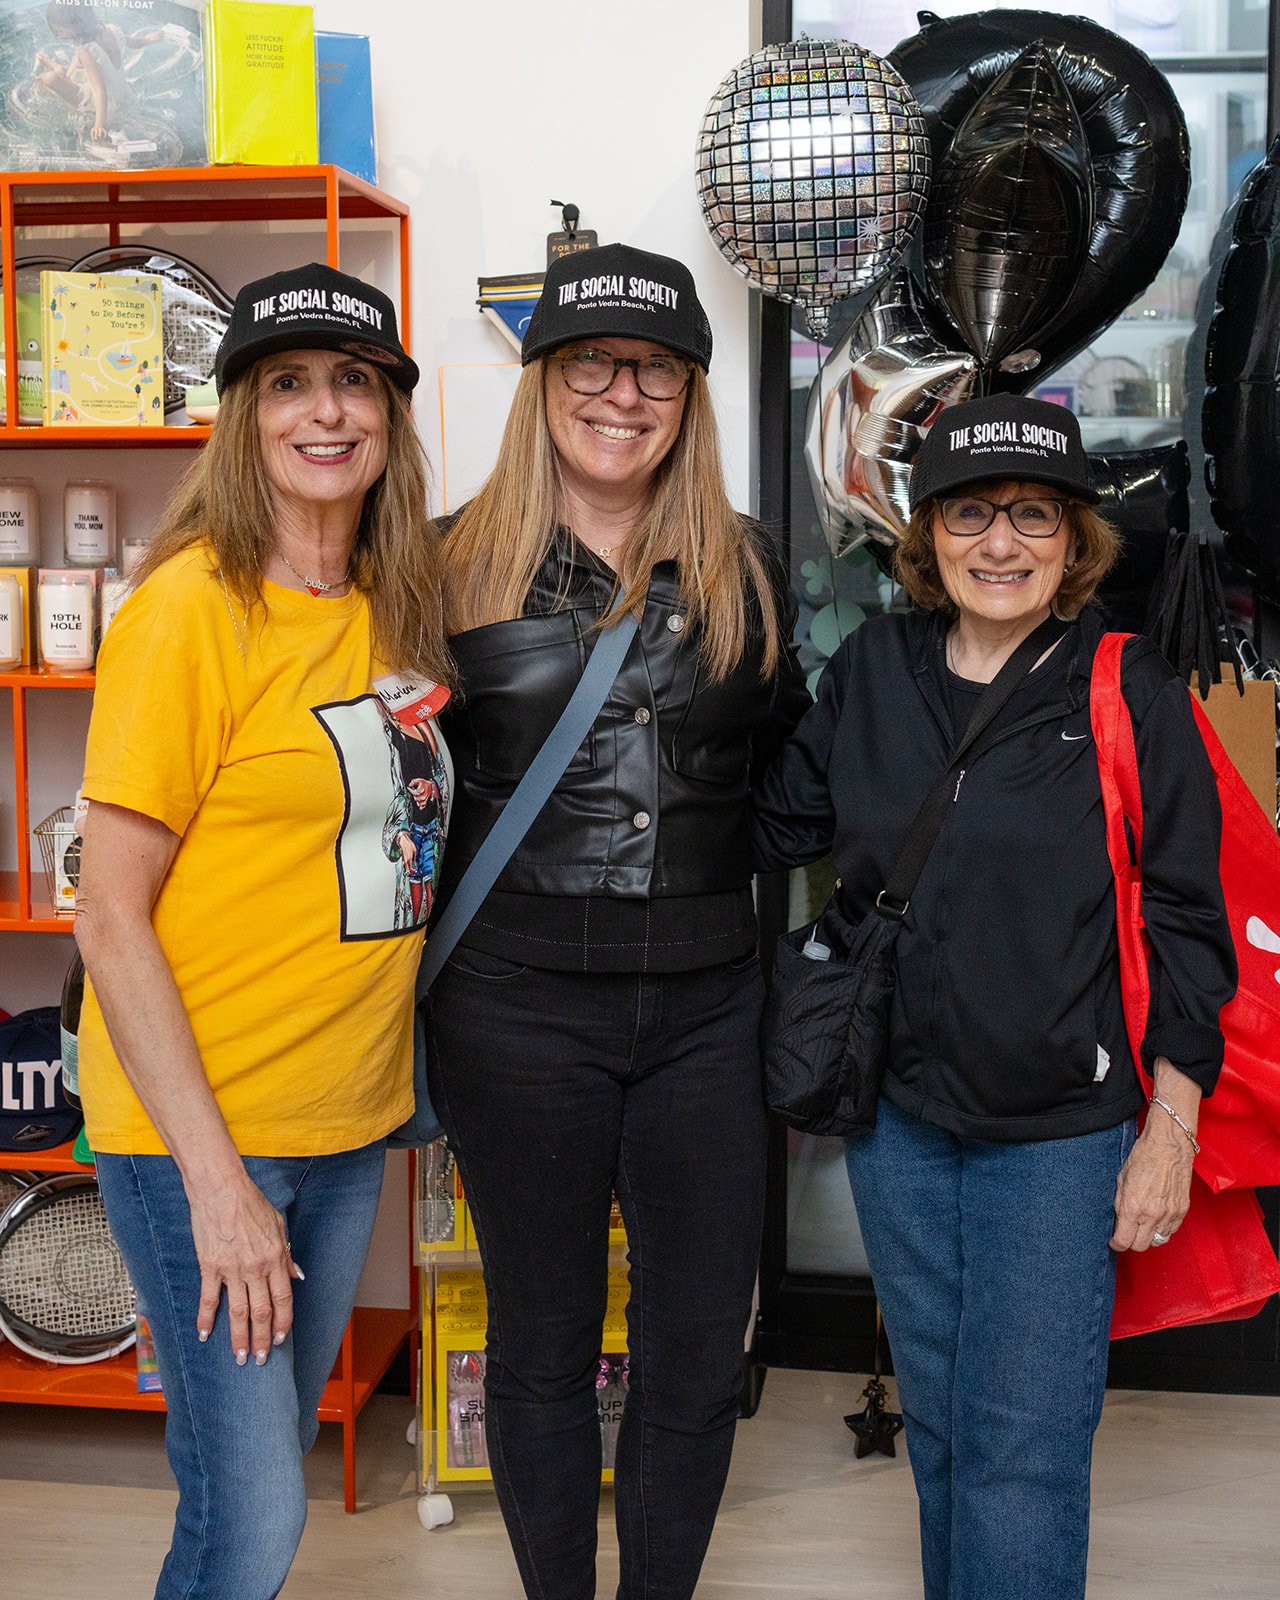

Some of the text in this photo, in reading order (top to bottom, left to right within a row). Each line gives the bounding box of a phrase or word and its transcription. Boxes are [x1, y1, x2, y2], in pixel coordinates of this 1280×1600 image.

[84, 0, 119, 8] LIE-ON
[123, 0, 154, 9] FLOAT
[245, 33, 259, 41] LESS
[246, 43, 284, 52] ATTITUDE
[246, 60, 285, 69] GRATITUDE
[573, 242, 590, 251] THE
[558, 281, 579, 306] THE
[102, 298, 145, 310] 50 Things
[576, 300, 657, 314] Ponte Vedra Beach, FL
[252, 295, 277, 323] THE
[103, 310, 113, 318] Do
[116, 311, 145, 319] Before
[110, 320, 145, 329] You're 5
[276, 312, 362, 330] Ponte Vedra Beach, FL
[949, 426, 971, 452] THE
[970, 445, 1049, 458] Ponte Vedra Beach, FL
[78, 514, 99, 522] THANK
[0, 519, 24, 527] OME
[74, 522, 88, 530] YOU,
[52, 613, 81, 621] 19TH
[50, 622, 82, 630] HOLE
[379, 684, 417, 704] Marlene
